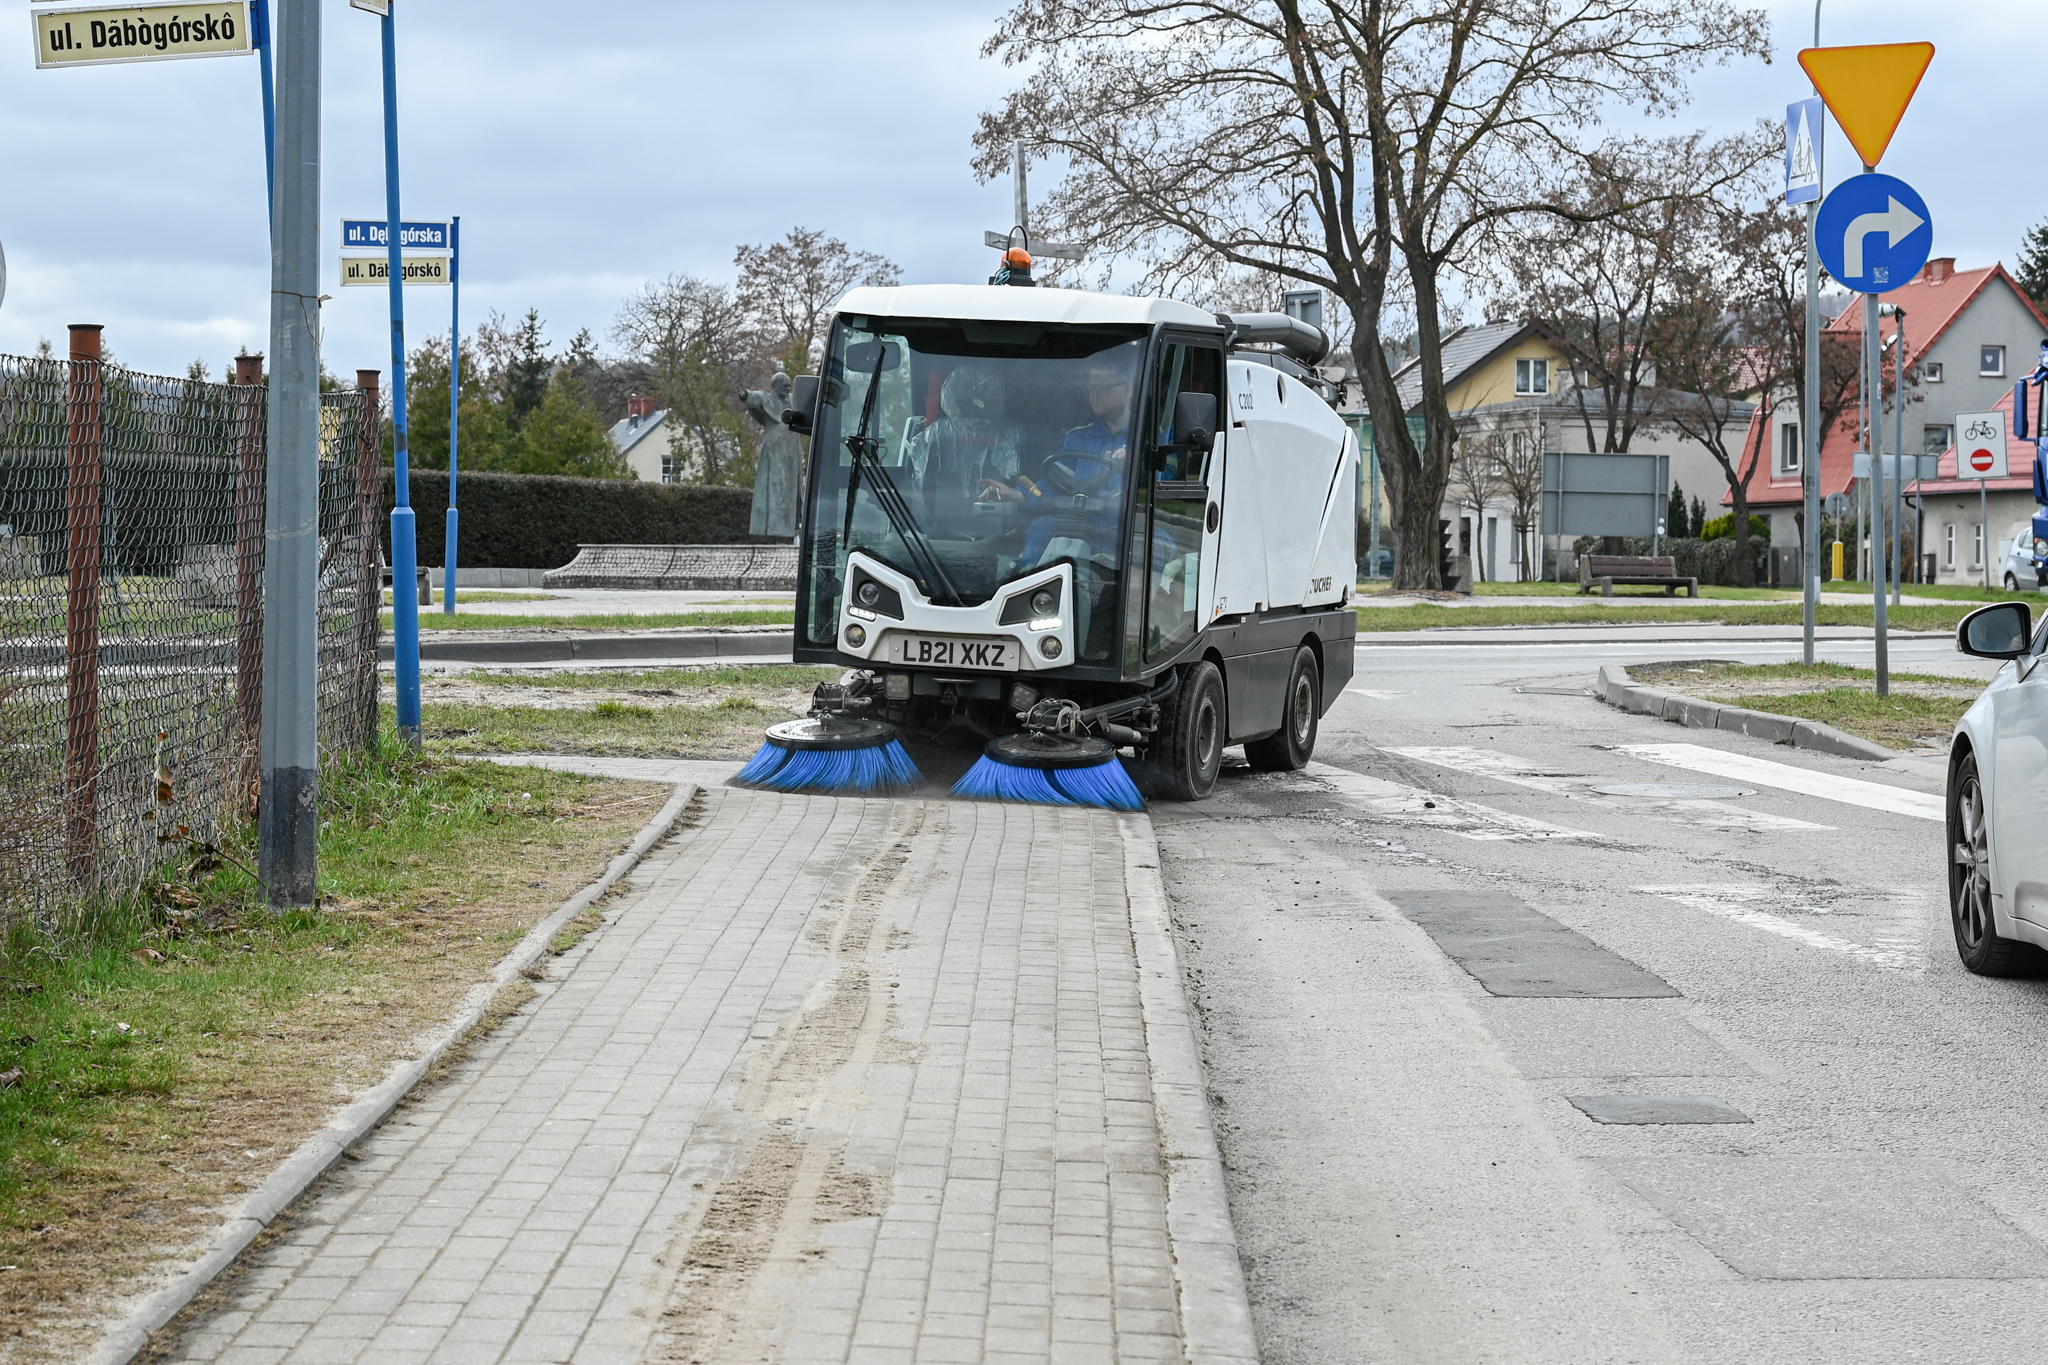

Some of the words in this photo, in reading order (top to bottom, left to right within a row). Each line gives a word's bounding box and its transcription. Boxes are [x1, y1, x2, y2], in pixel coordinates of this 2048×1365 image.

[50, 22, 82, 51] ul.
[90, 12, 236, 50] Dãbògórskô
[348, 225, 366, 241] ul.
[347, 263, 365, 278] ul.
[903, 640, 954, 664] LB21
[960, 642, 1005, 667] XKZ
